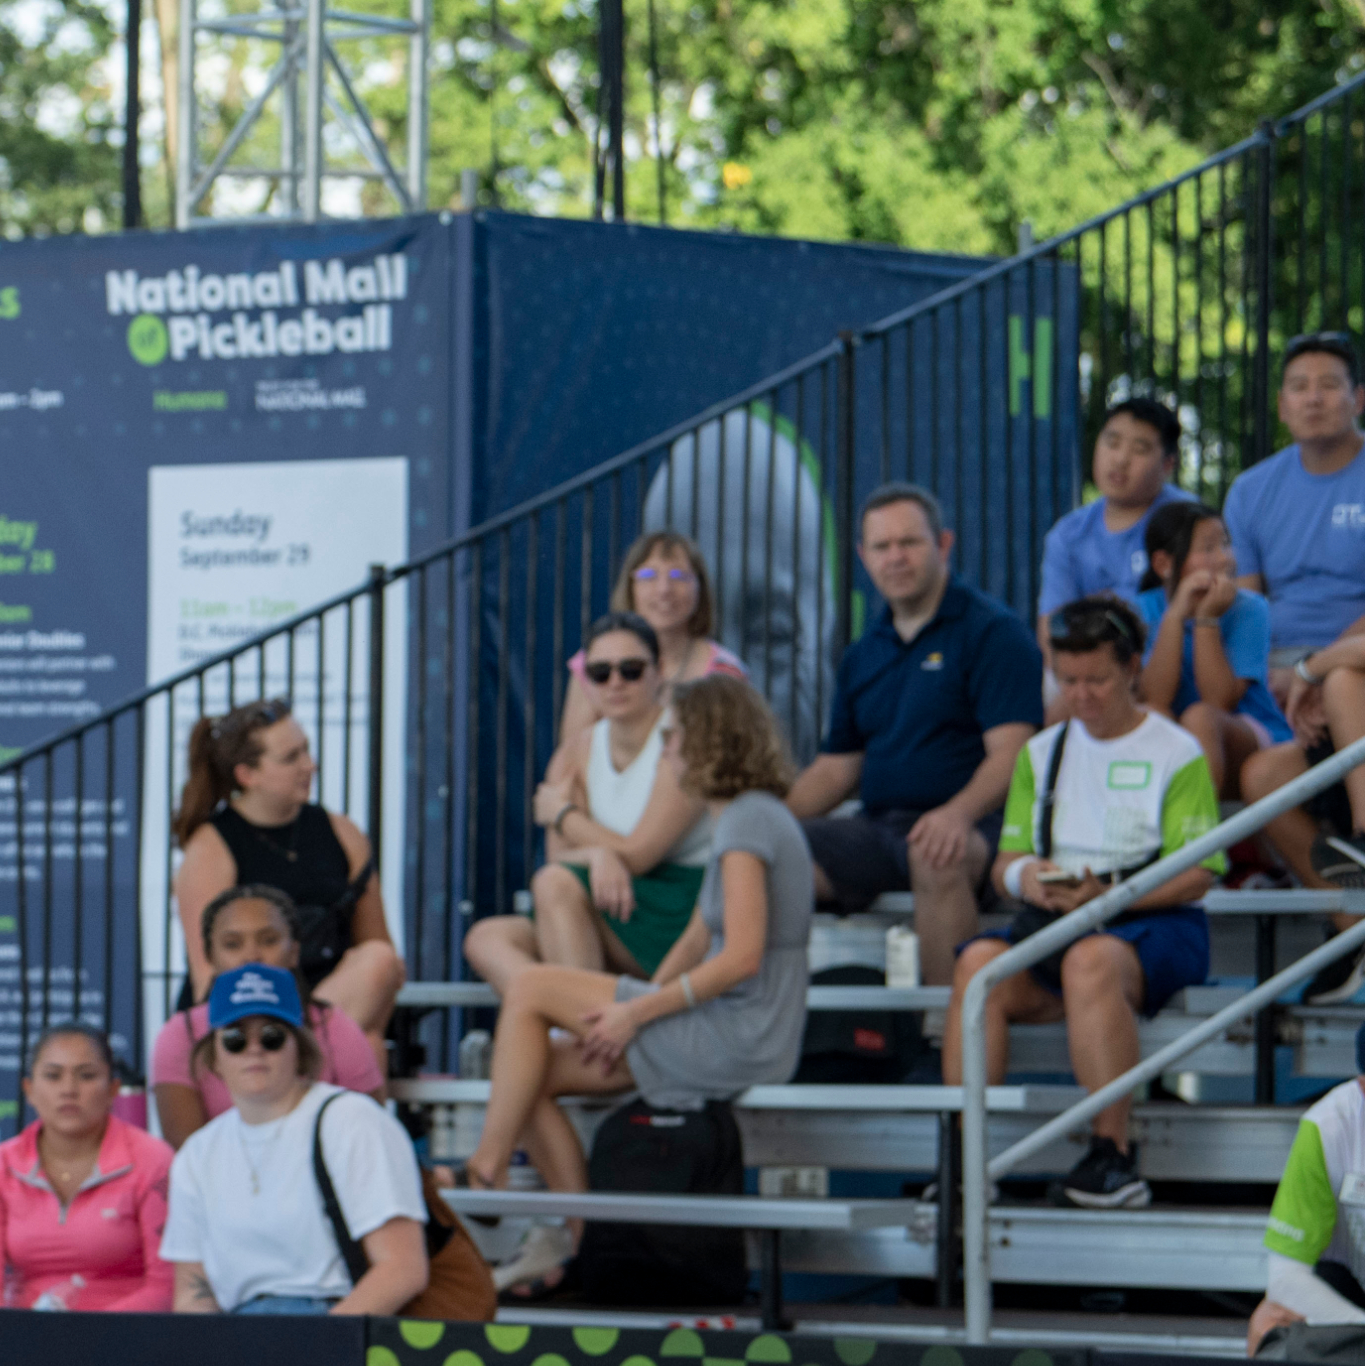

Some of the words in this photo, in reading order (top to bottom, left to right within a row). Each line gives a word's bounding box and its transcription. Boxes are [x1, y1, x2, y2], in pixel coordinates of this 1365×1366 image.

[105, 260, 299, 315] National
[304, 252, 408, 304] Mall
[168, 303, 392, 361] Pickleball
[180, 508, 273, 542] Sunday
[179, 545, 281, 570] September
